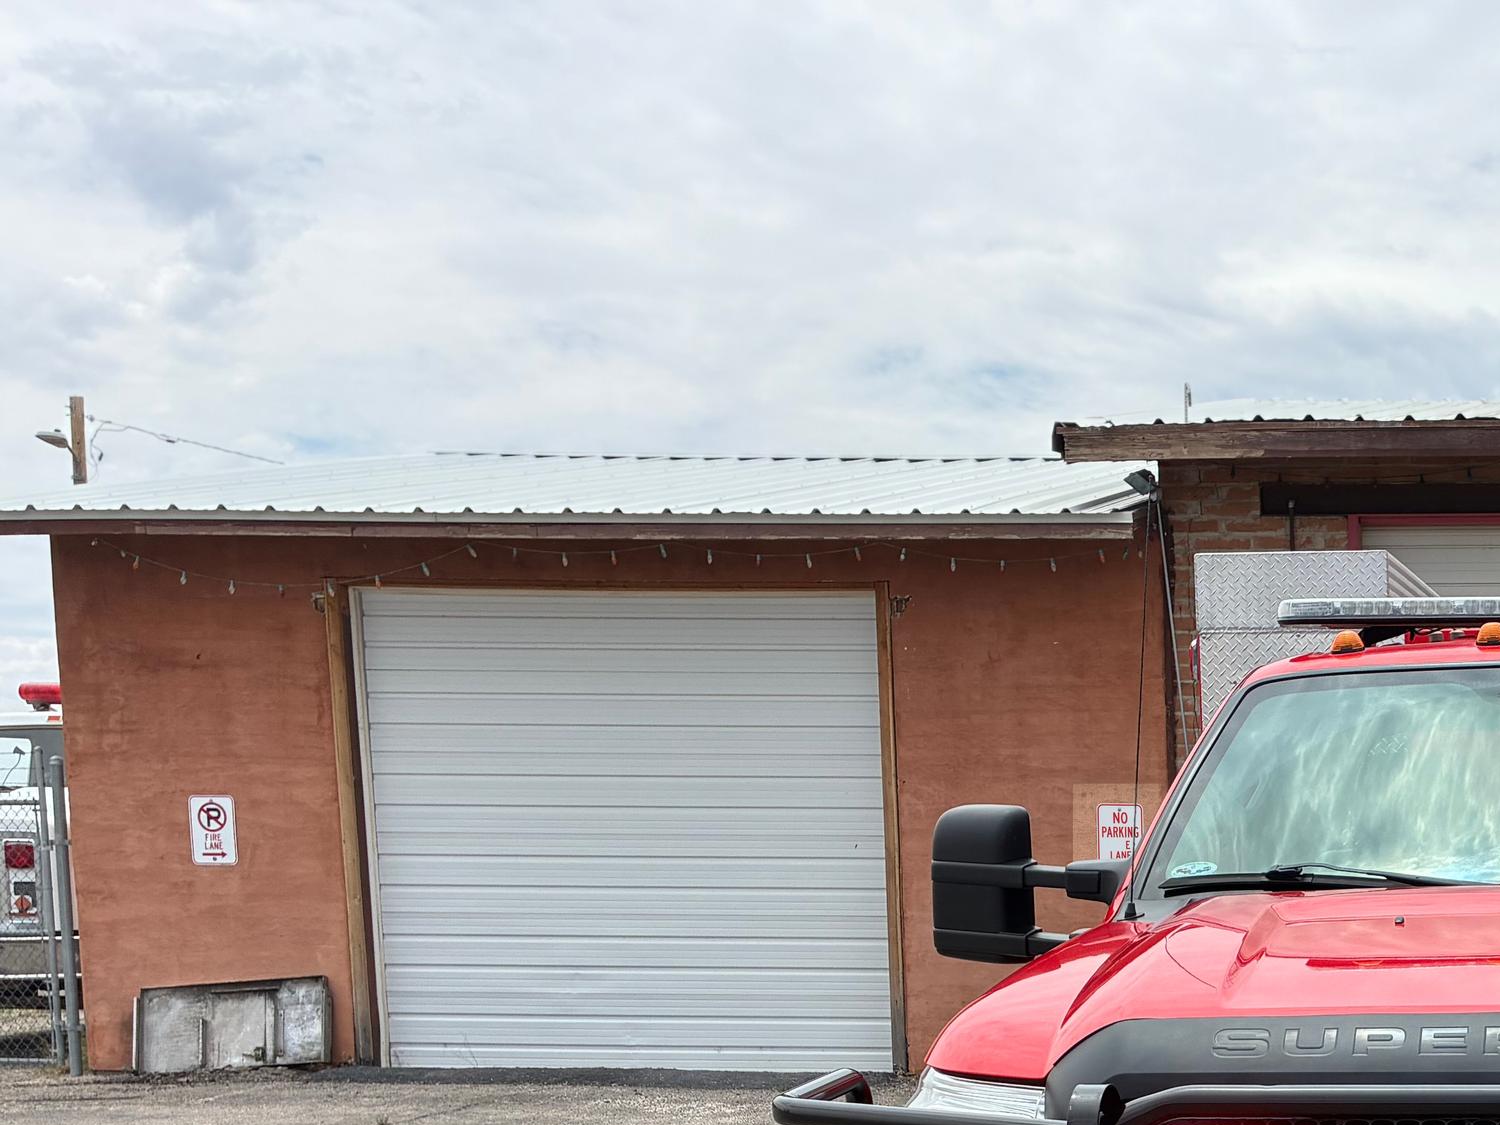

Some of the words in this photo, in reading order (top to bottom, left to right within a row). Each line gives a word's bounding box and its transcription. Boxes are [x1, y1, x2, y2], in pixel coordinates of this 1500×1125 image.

[1112, 811, 1128, 824] NO
[205, 833, 222, 841] FIRE
[1101, 826, 1139, 838] PARKING
[205, 841, 223, 850] LANE
